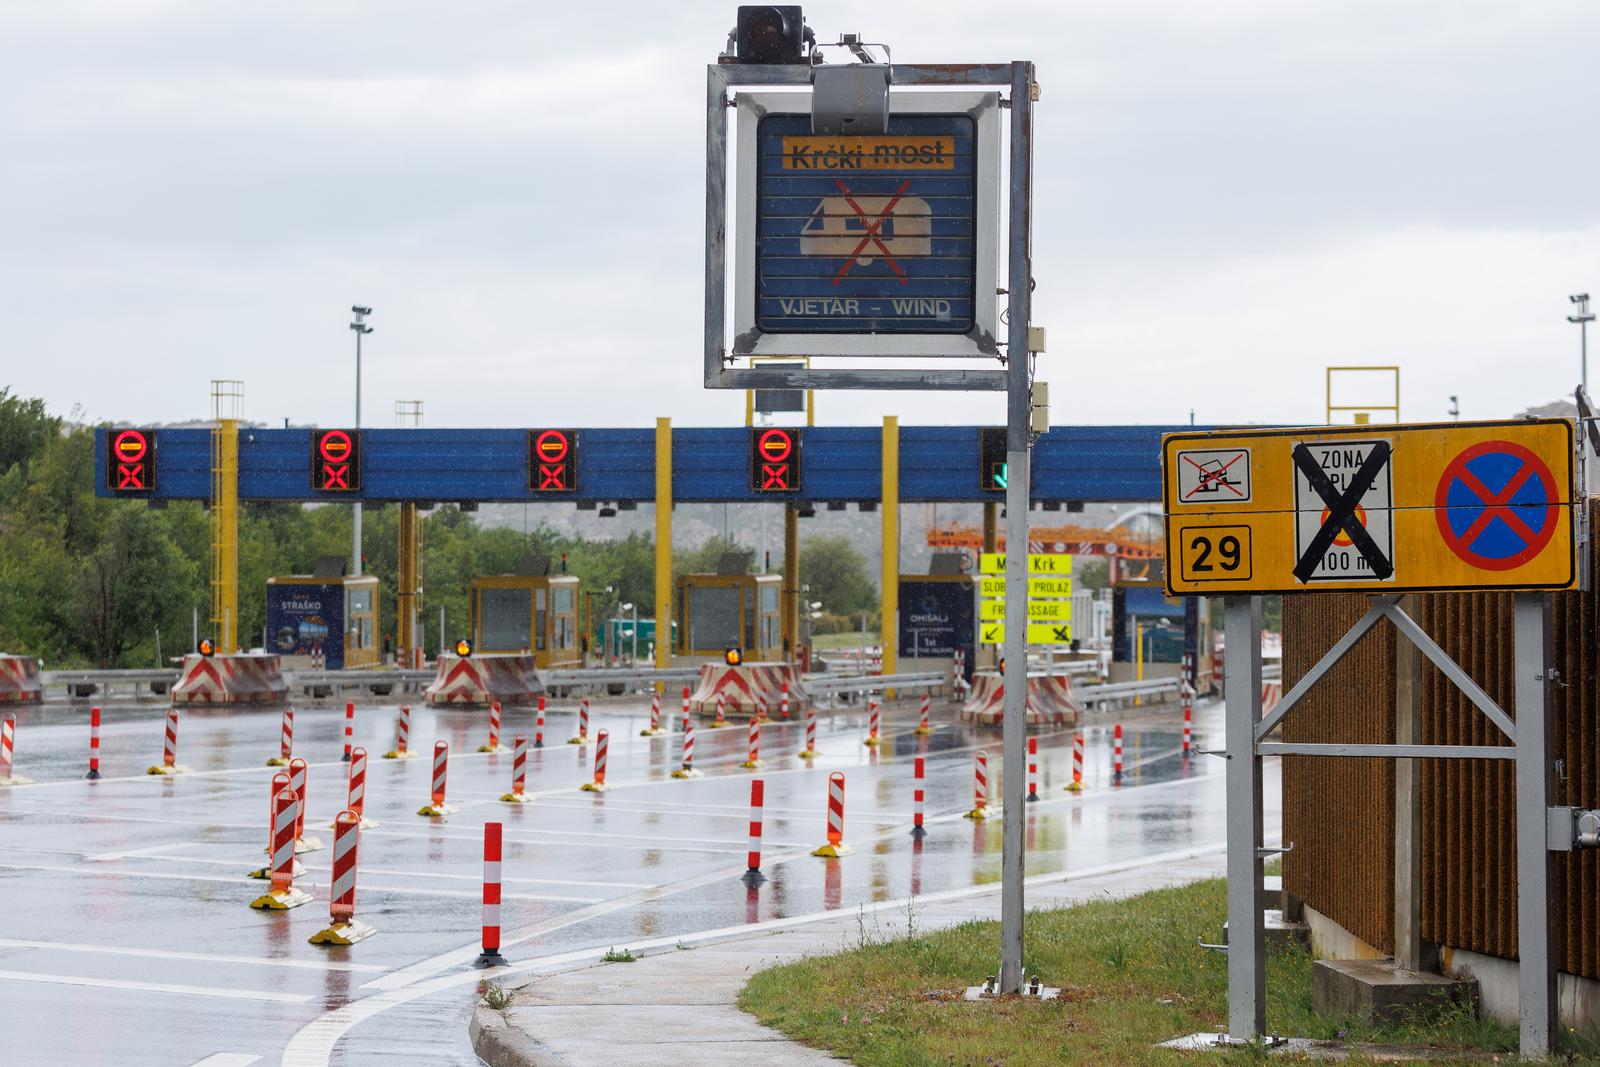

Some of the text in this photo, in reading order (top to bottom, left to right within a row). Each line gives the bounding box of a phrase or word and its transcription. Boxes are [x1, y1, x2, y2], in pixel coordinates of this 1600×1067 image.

[792, 141, 945, 169] Krčki most
[779, 299, 860, 315] VJETAR
[891, 299, 951, 316] WIND
[1321, 450, 1364, 469] ZONA
[1191, 535, 1241, 572] 29
[1321, 552, 1350, 570] 100
[1034, 558, 1057, 571] Krk
[1034, 582, 1069, 593] PROLAZ
[282, 600, 322, 610] STRAŠKO
[910, 613, 949, 622] OMIŠALJ
